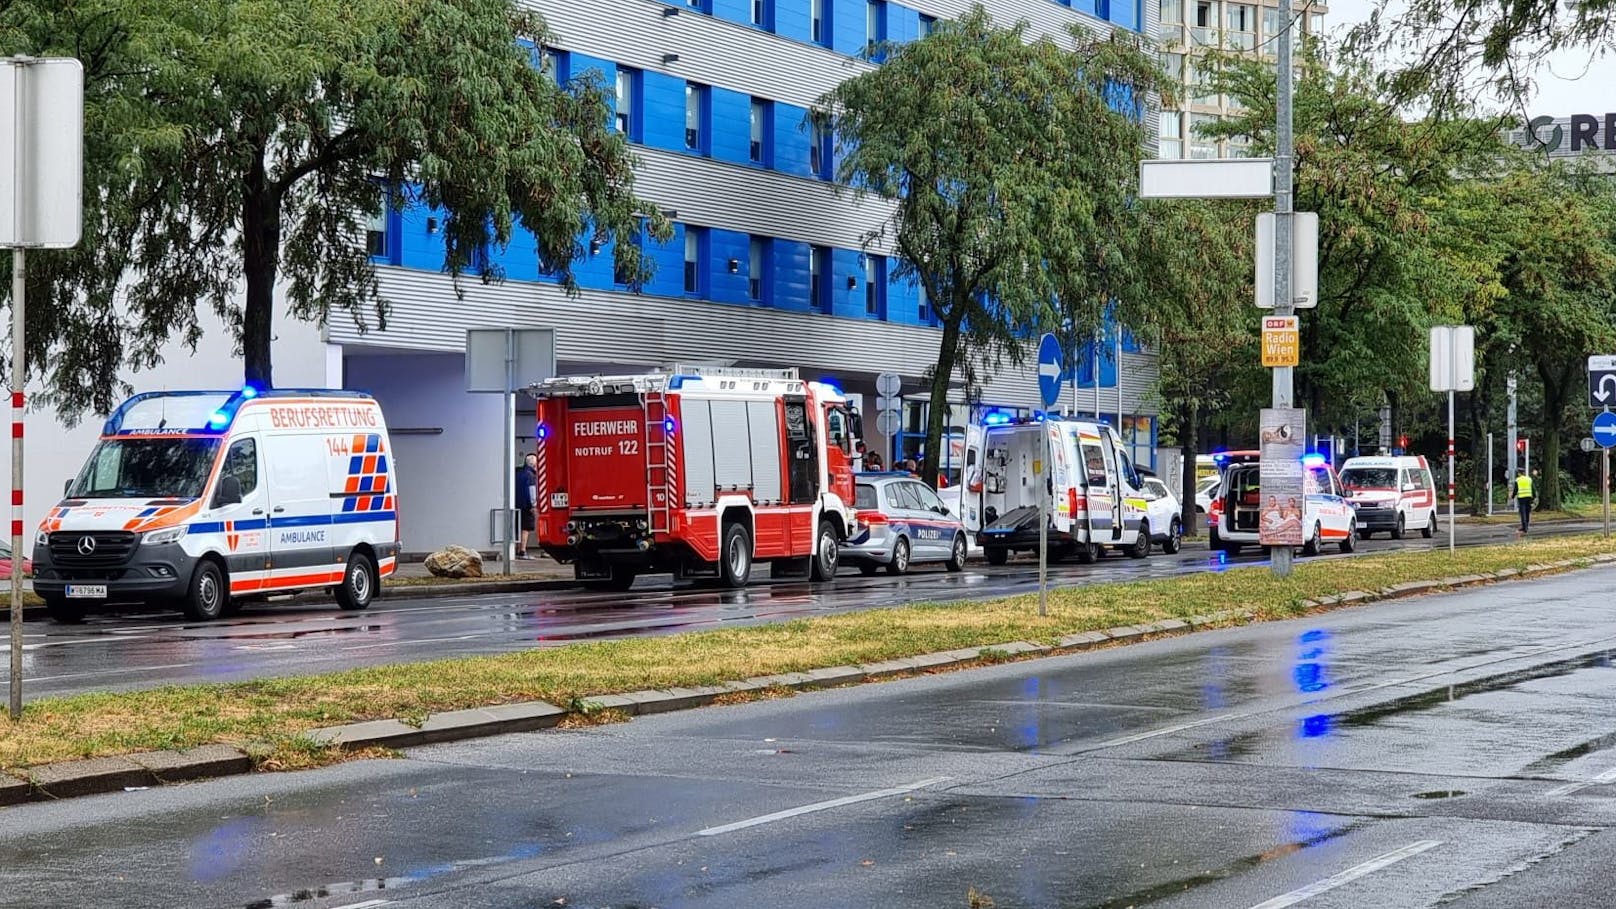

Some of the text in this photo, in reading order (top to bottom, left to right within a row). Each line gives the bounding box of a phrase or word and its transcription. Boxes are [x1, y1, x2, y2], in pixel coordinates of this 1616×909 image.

[1266, 332, 1295, 343] Radio
[1266, 344, 1294, 355] Wien
[270, 407, 377, 429] BERUFSRETTUNG
[129, 427, 189, 436] AMBULANCE
[574, 420, 638, 436] FEUERWEHR
[326, 437, 349, 456] 144
[575, 440, 638, 456] NOTRUF 122
[656, 493, 665, 502] 10
[280, 530, 325, 544] AMBULANCE
[917, 529, 940, 540] POLIZEI
